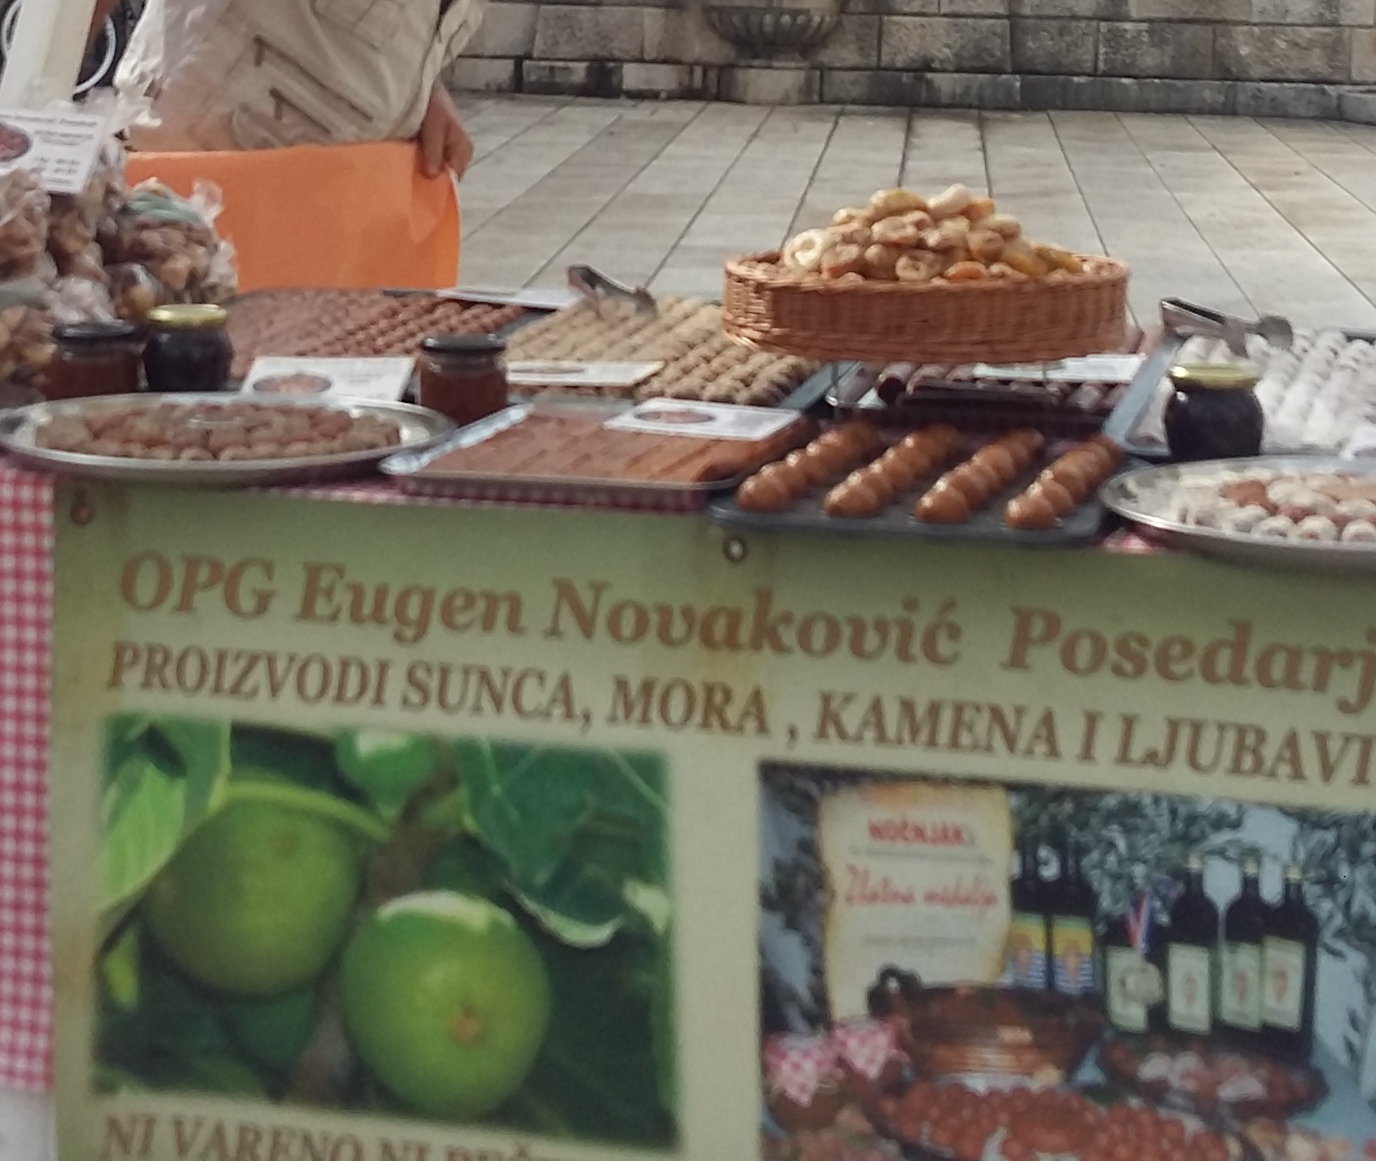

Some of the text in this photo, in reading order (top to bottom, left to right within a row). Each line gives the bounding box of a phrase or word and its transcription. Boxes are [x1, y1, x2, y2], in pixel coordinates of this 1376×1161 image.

[119, 550, 277, 621] OPG
[295, 560, 525, 644] Eugen
[547, 575, 964, 670] Novaković
[106, 642, 389, 709] PROIZVODI
[399, 659, 595, 735] SUNCA,
[812, 693, 1062, 764] KAMENA
[1075, 710, 1105, 763] I
[104, 1112, 157, 1158] NI
[172, 1114, 365, 1161] VARENO
